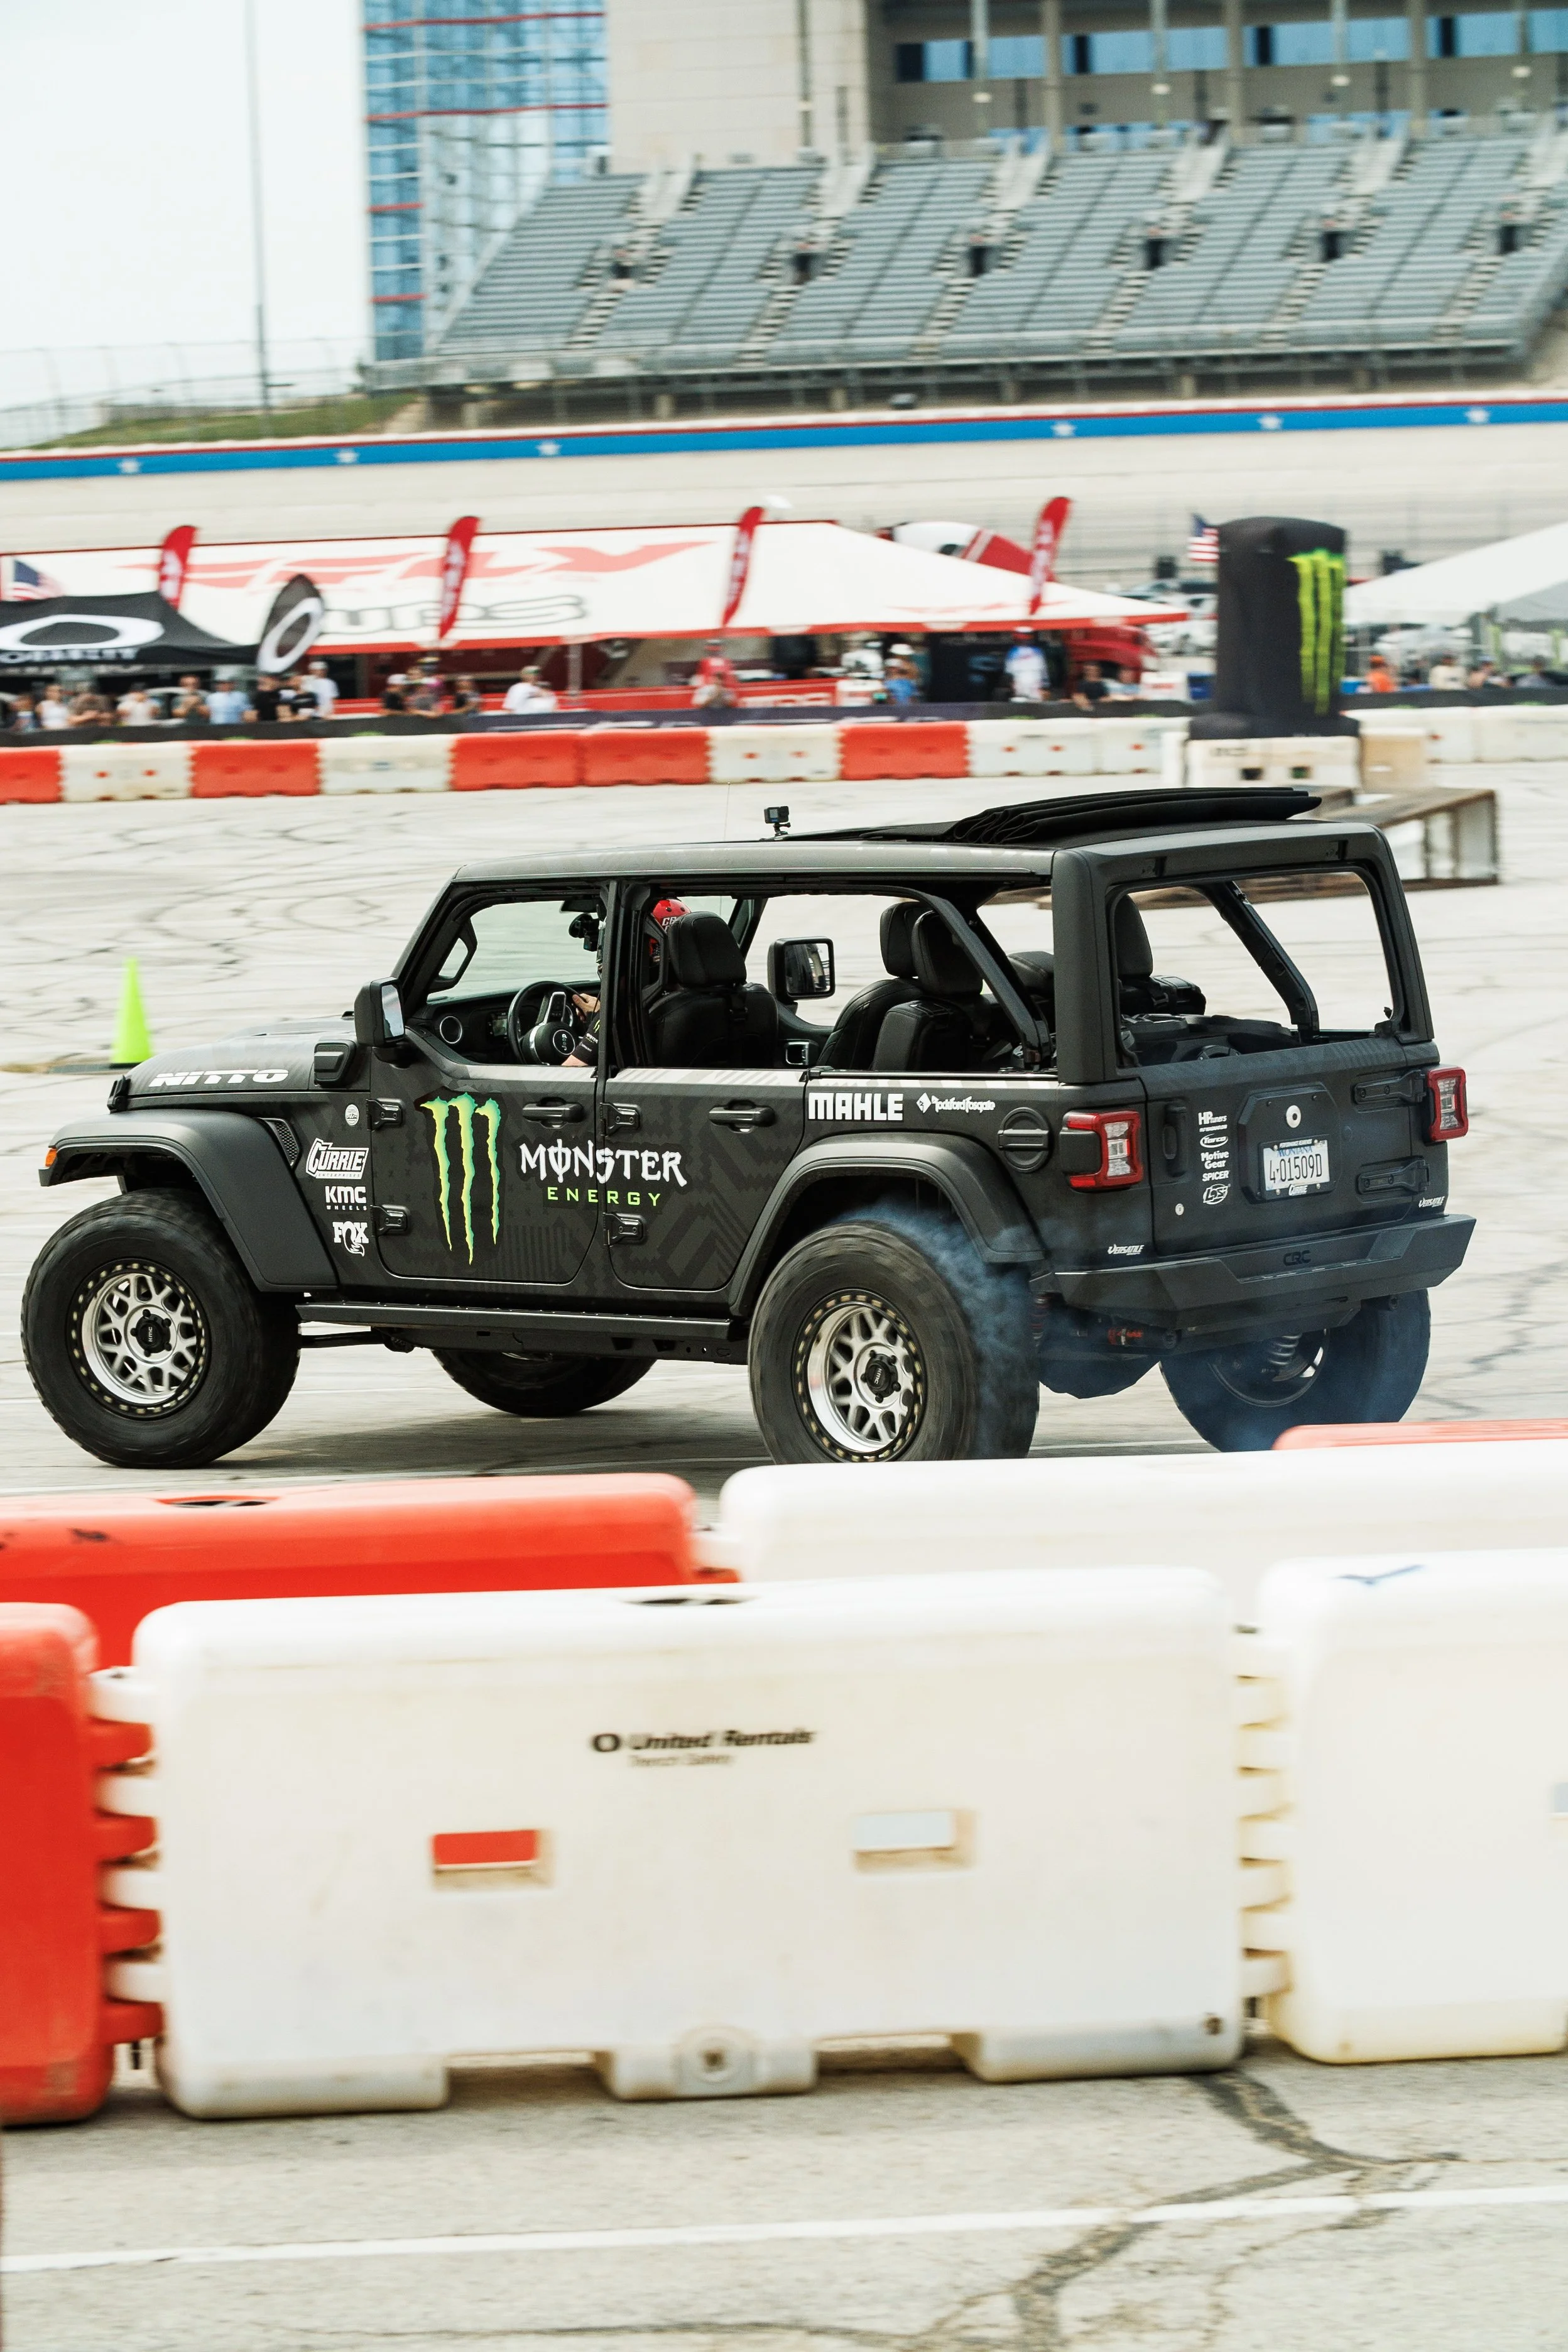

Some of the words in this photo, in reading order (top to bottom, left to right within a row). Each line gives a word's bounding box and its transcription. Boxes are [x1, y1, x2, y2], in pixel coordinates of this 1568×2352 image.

[148, 1069, 289, 1087] NITTO
[808, 1092, 904, 1121] MAHLE
[307, 1140, 367, 1175] CURRIE
[1200, 1150, 1229, 1162] Motive
[1277, 1145, 1314, 1157] MONTANA
[519, 1138, 688, 1187] MONSTER
[1204, 1160, 1226, 1170] Gear
[1202, 1170, 1229, 1182] SPICER
[325, 1185, 367, 1204] KMC
[547, 1187, 661, 1206] ENERGY
[332, 1221, 369, 1256] FOX
